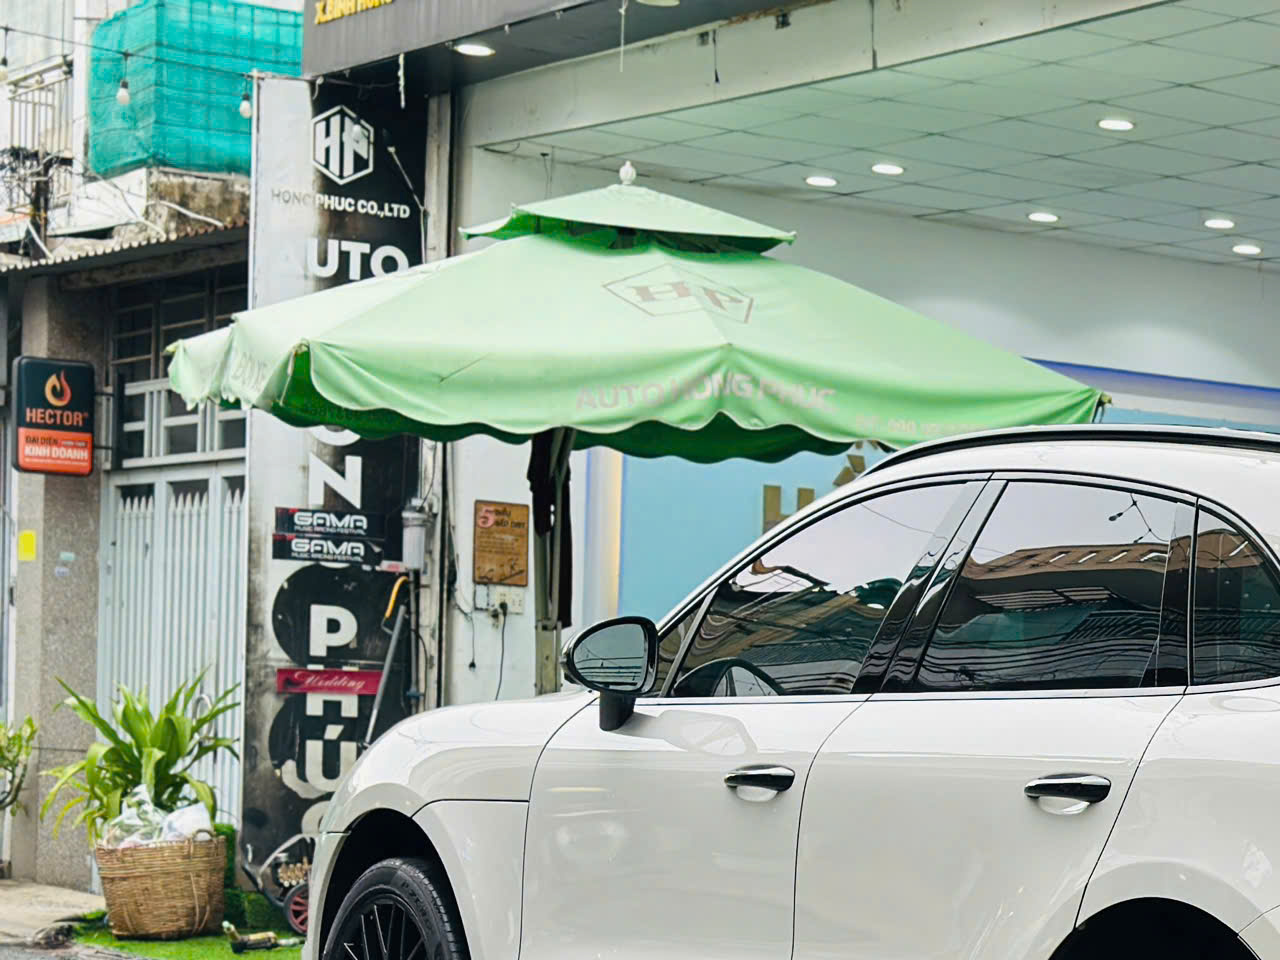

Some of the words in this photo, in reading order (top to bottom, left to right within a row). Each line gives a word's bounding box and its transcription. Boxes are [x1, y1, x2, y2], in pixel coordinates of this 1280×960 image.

[315, 193, 355, 213] PHUC
[306, 237, 410, 281] UTO
[25, 407, 83, 427] HECTOR
[293, 511, 368, 531] GAMA
[291, 538, 365, 557] GAMA
